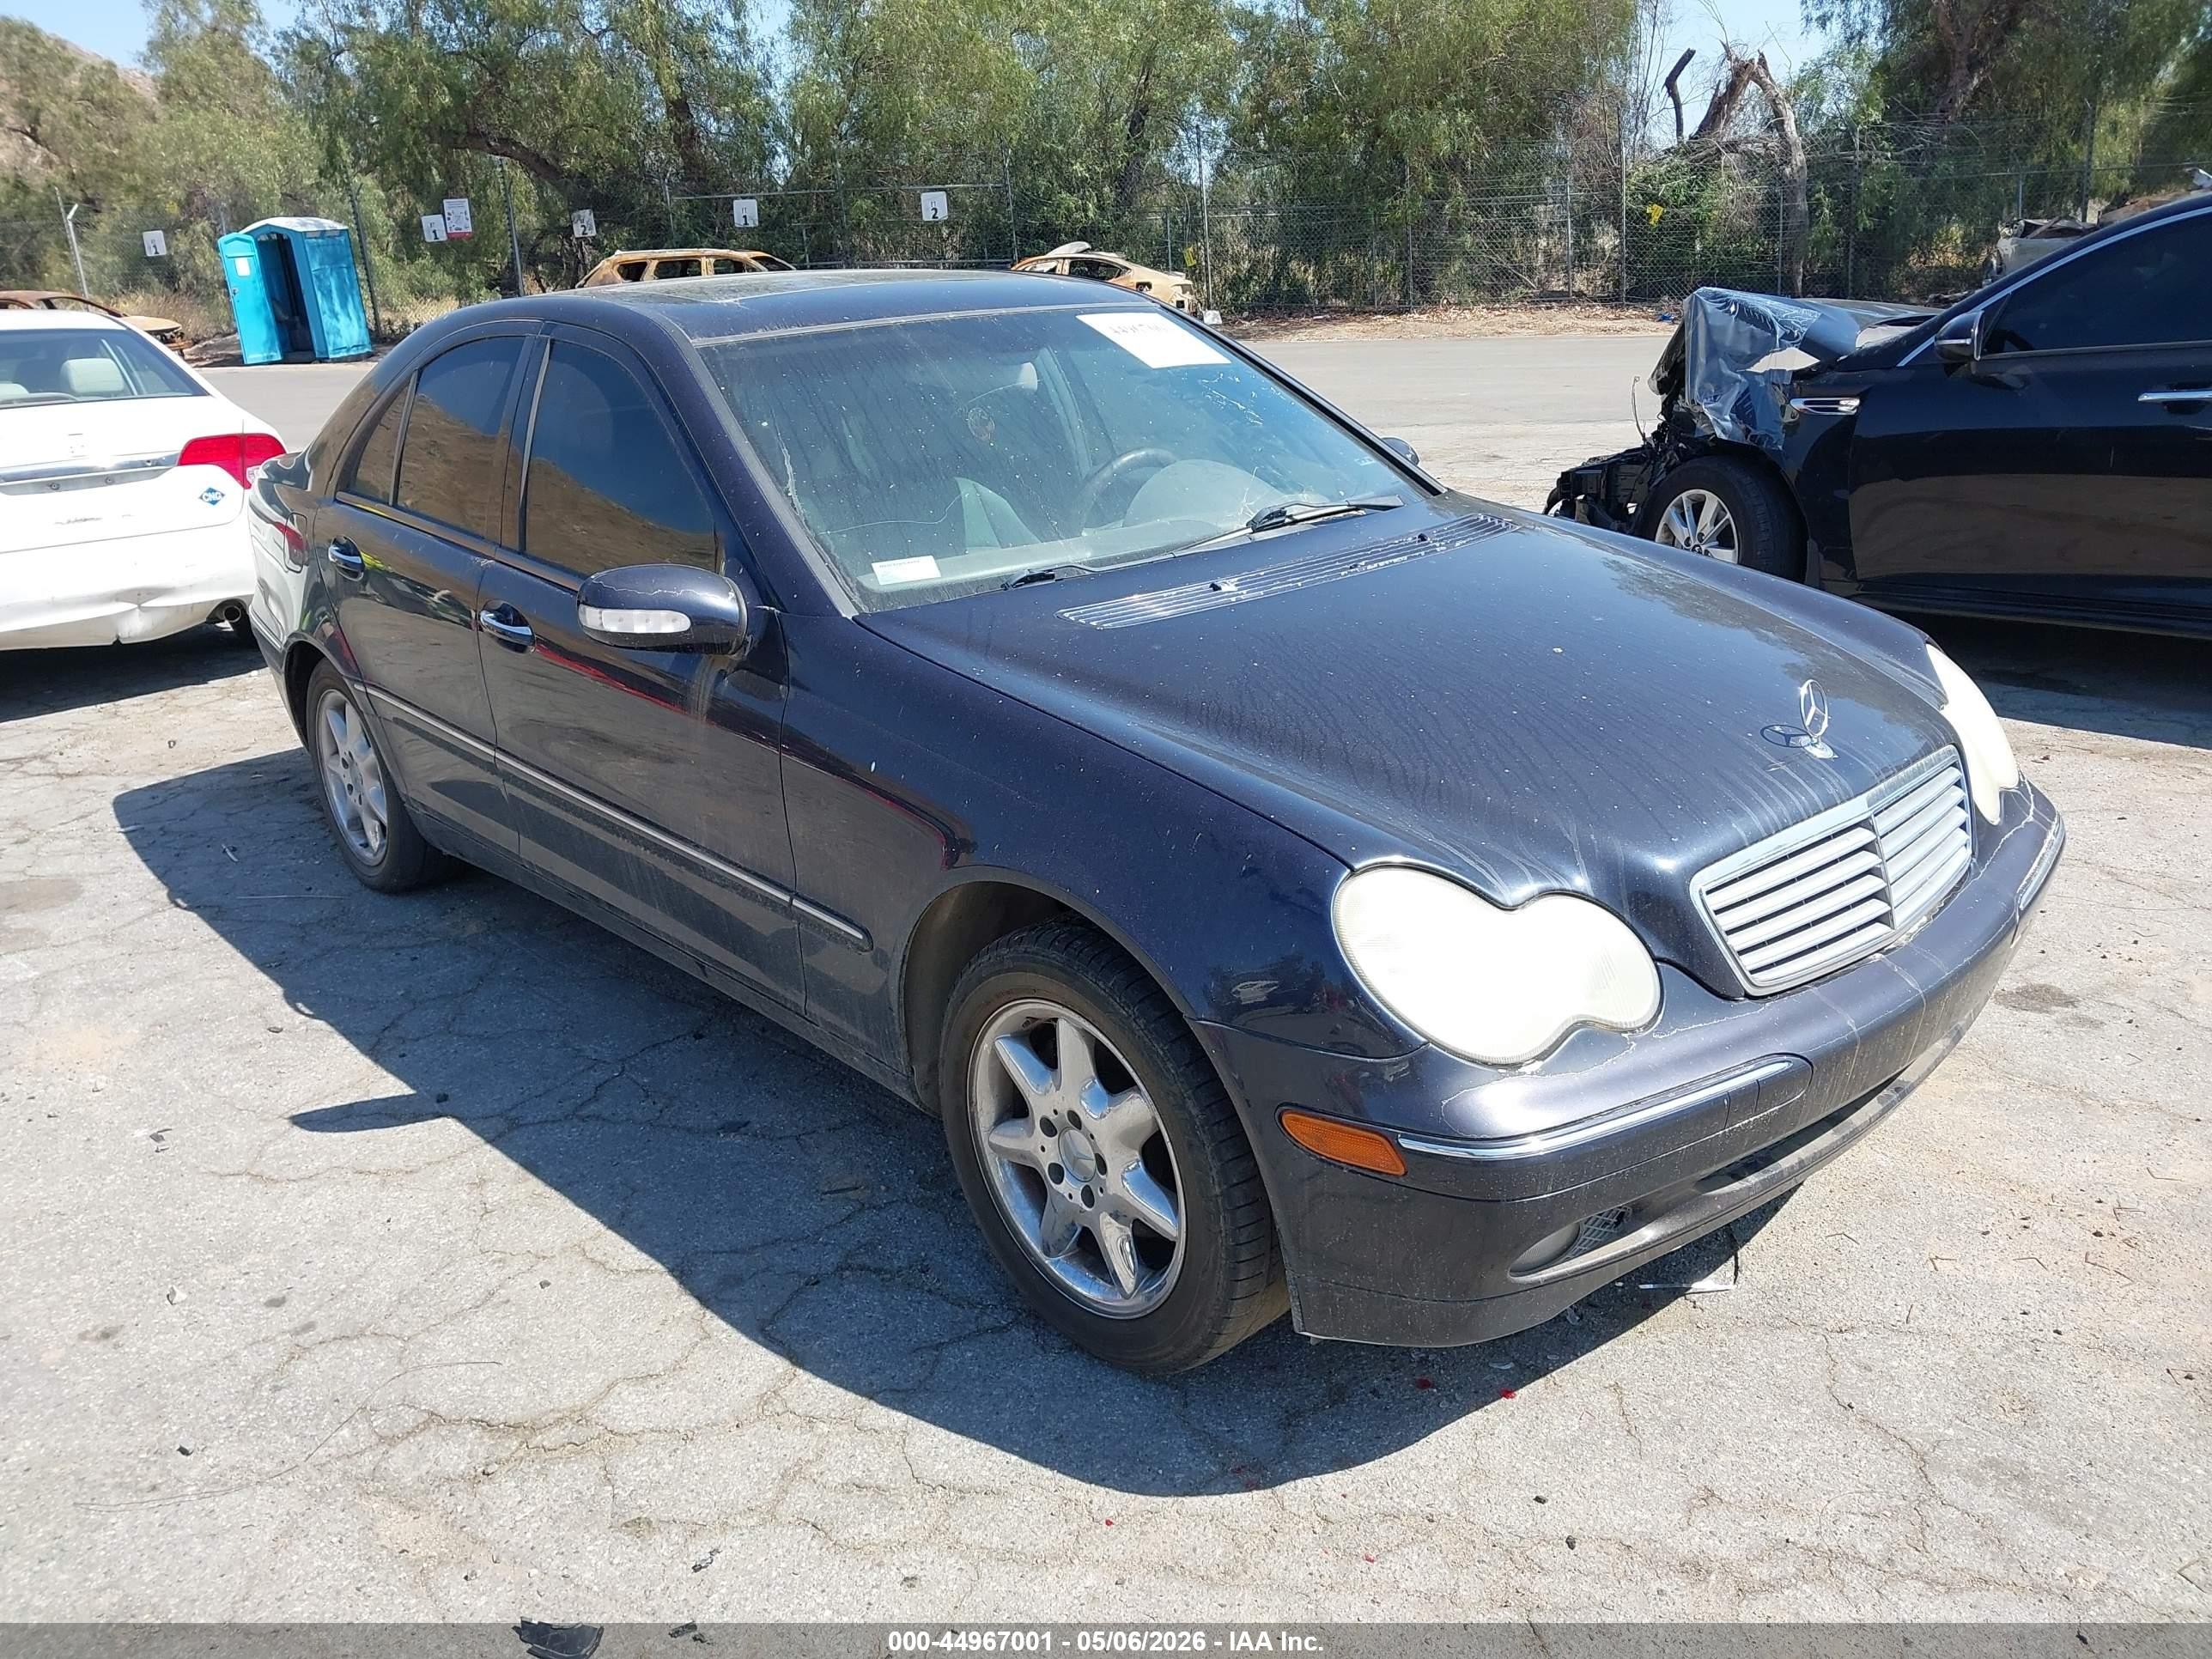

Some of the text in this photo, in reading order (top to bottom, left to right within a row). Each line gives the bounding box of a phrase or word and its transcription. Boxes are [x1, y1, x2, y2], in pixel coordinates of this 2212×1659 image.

[931, 207, 939, 219] 2
[742, 214, 750, 226] 1
[432, 229, 440, 240] 1
[580, 224, 588, 235] 2
[152, 244, 160, 255] 1
[202, 490, 222, 502] CNG
